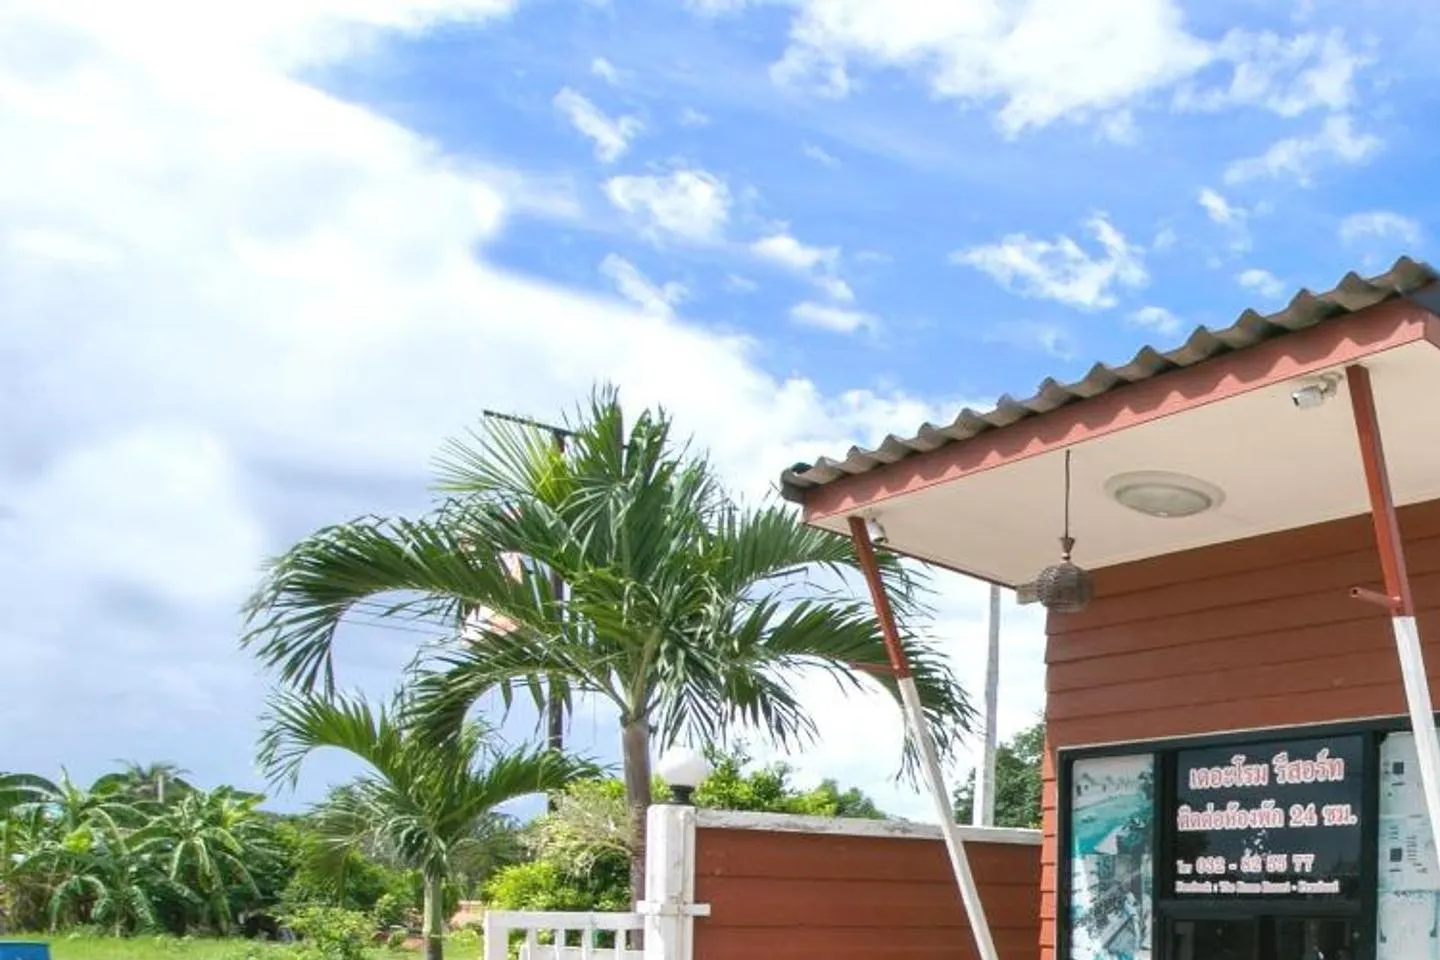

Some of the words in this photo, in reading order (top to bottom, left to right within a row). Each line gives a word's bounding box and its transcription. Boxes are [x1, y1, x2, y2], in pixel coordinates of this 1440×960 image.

[1272, 748, 1344, 784] รีสอร์ท
[1289, 803, 1317, 827] 24
[1321, 803, 1358, 826] ชม.
